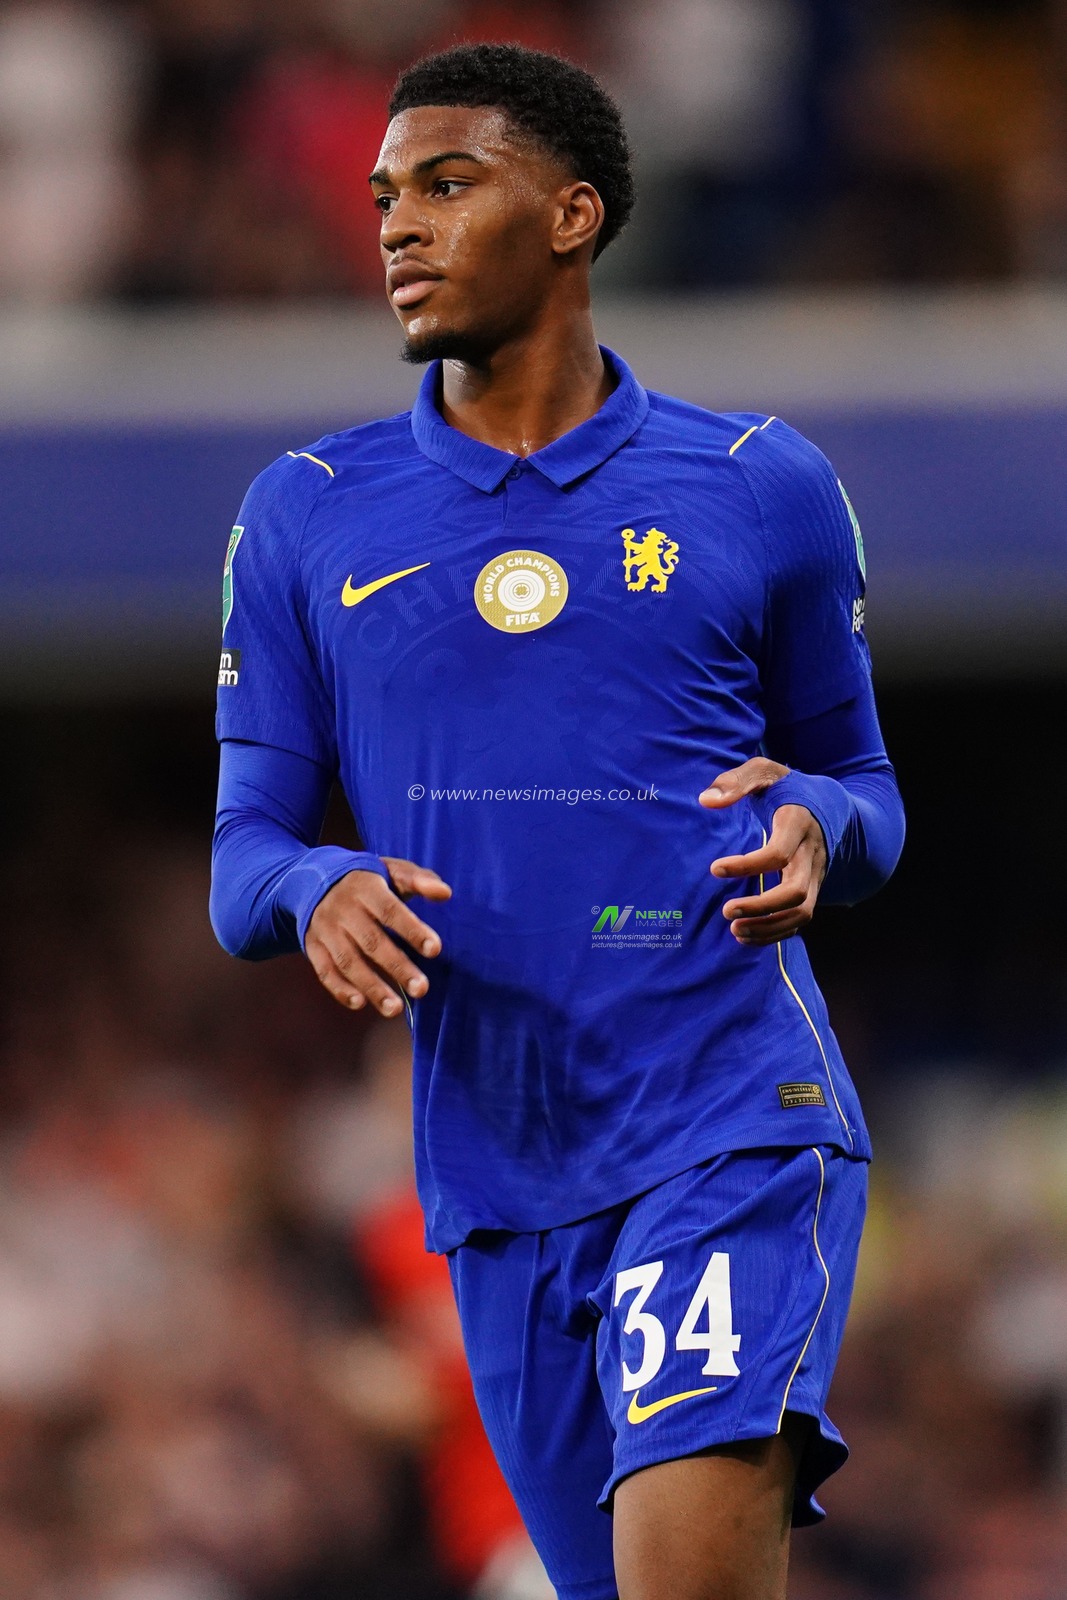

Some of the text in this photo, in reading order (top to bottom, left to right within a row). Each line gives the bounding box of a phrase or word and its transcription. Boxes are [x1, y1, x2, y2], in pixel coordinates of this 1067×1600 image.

[483, 556, 560, 604] WORLD CHAMPIONS
[505, 612, 541, 627] FIFA
[613, 1252, 742, 1392] 34
